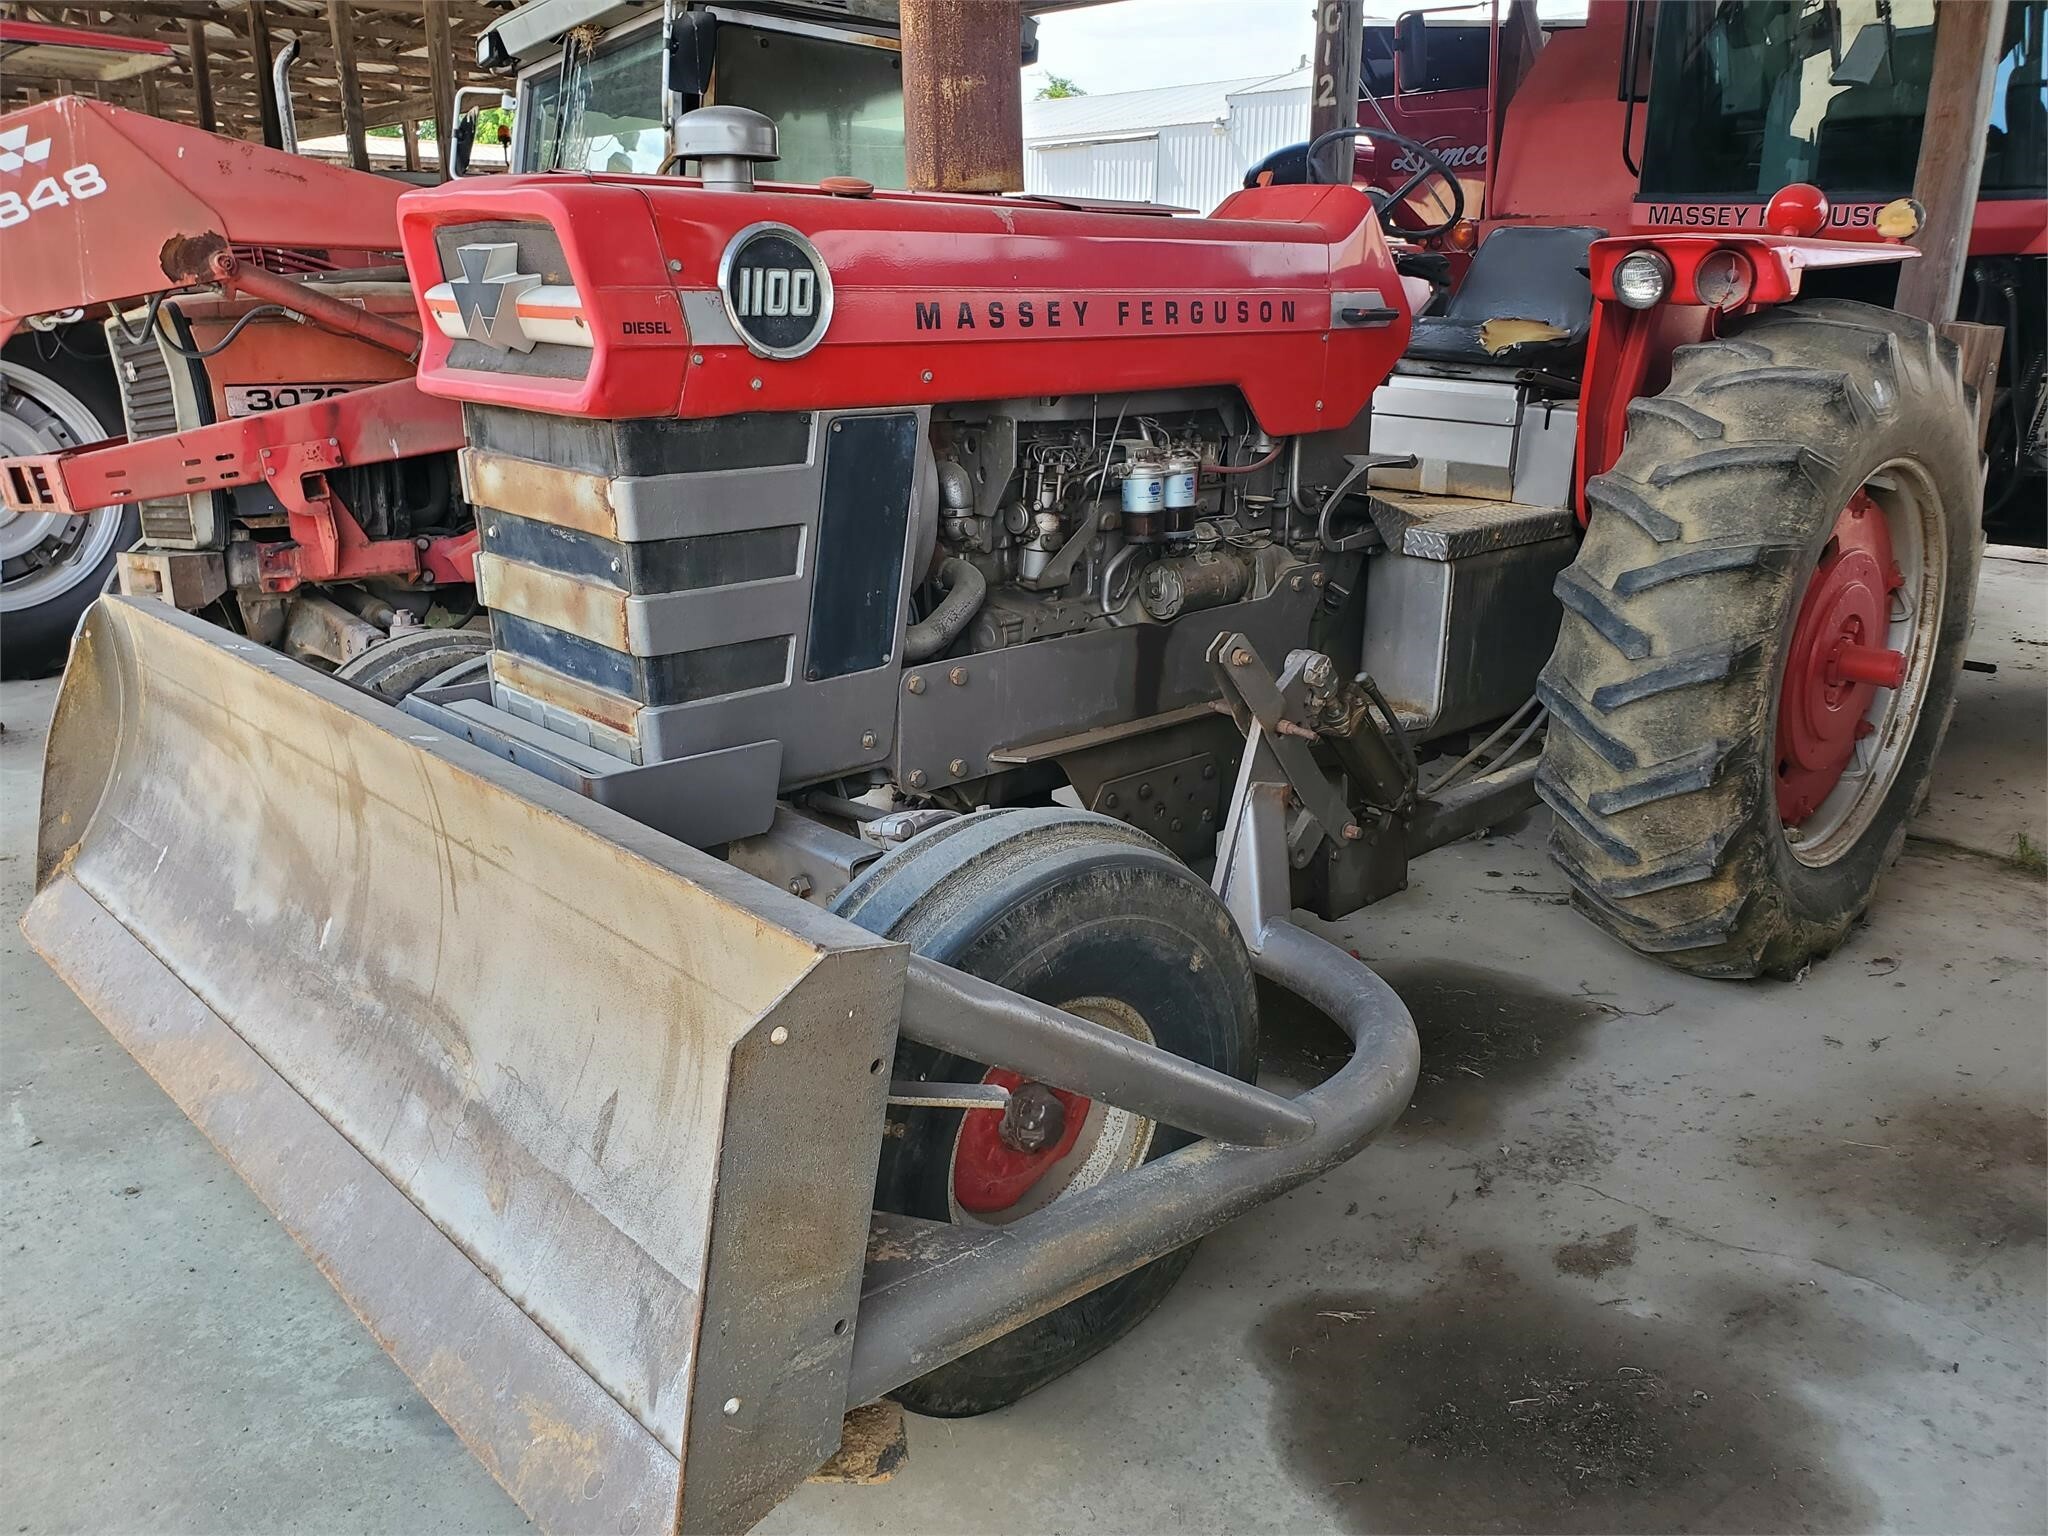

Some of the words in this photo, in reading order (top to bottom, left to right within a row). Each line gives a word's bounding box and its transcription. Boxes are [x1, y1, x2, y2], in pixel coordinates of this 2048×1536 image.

[0, 163, 107, 229] 848
[1648, 205, 1750, 226] MASSEY
[737, 267, 815, 317] 1100
[622, 321, 672, 335] DIESEL
[915, 300, 1089, 330] MASSEY
[1117, 300, 1296, 326] FERGUSON
